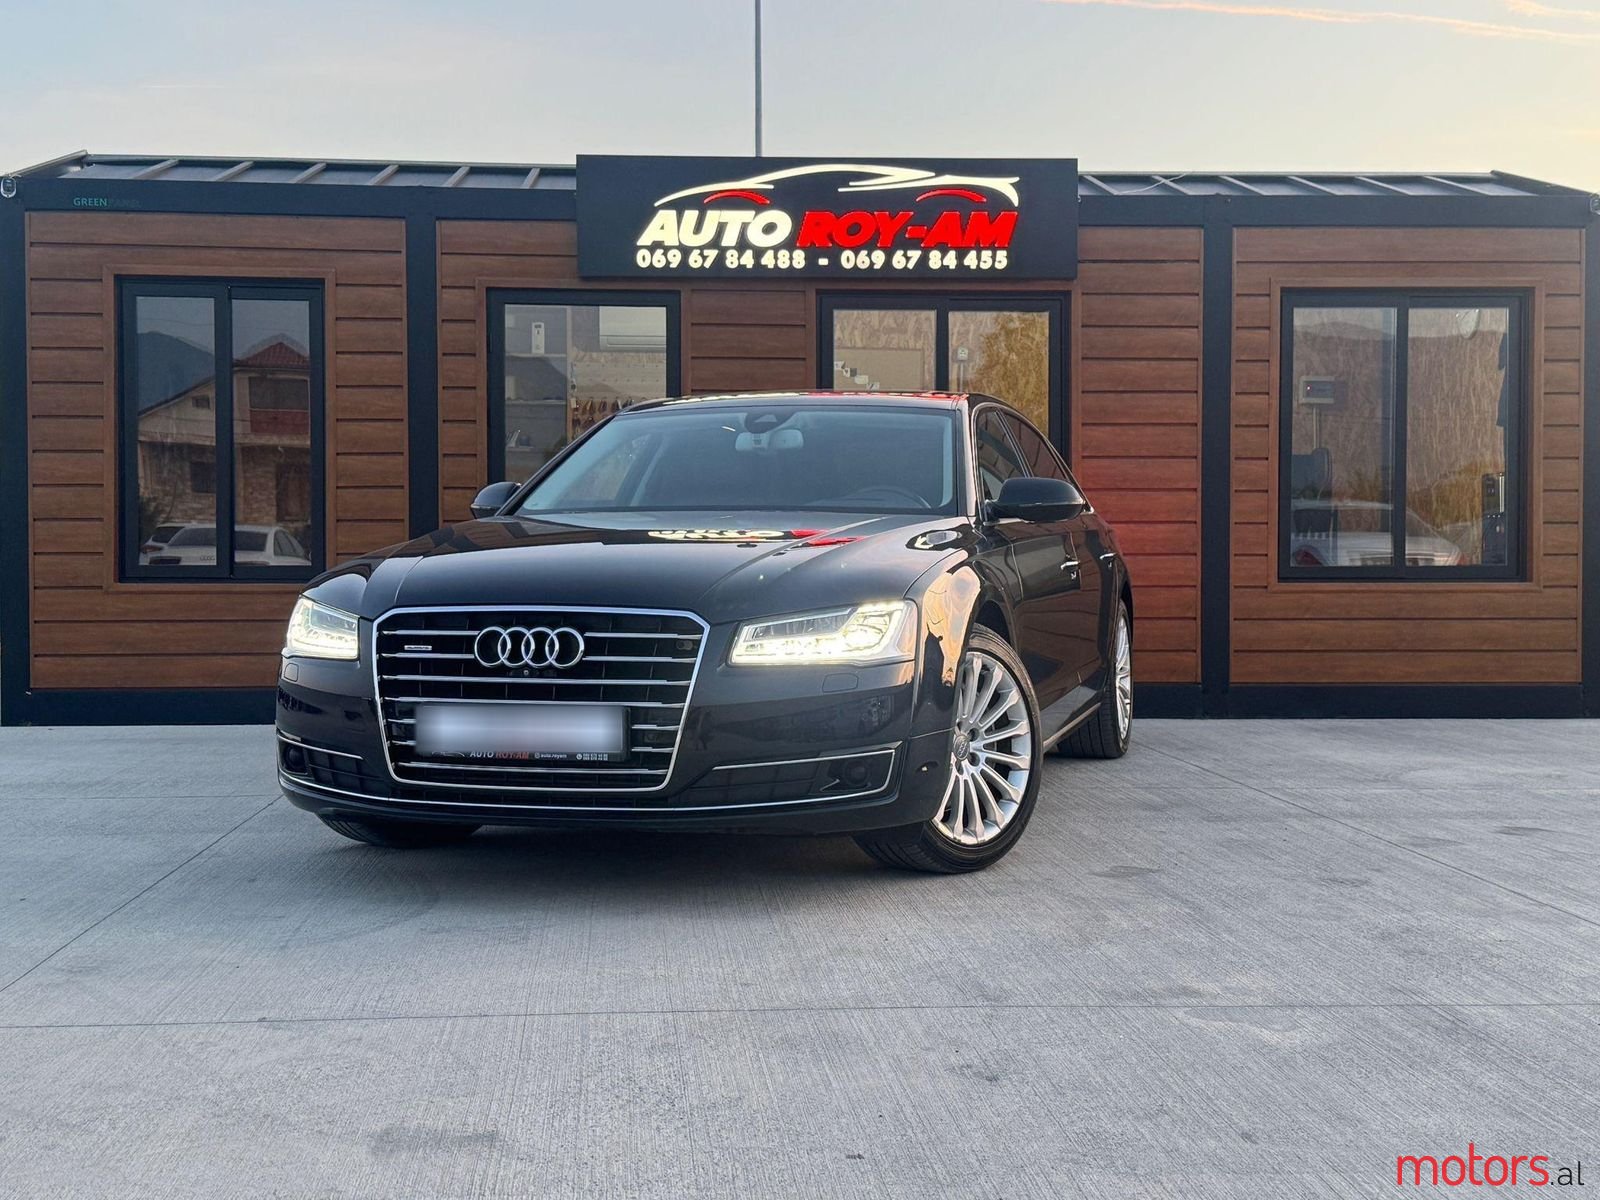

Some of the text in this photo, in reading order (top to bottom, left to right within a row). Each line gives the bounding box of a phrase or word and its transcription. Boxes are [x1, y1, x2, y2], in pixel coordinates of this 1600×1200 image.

[73, 197, 108, 207] GREEN
[636, 209, 1019, 248] AUTO ROY-AM
[636, 249, 682, 269] 069
[688, 249, 718, 269] 67
[726, 249, 755, 269] 84
[761, 249, 806, 269] 488
[840, 250, 885, 269] 069
[892, 250, 922, 269] 67
[928, 250, 957, 269] 84
[964, 250, 1008, 269] 455
